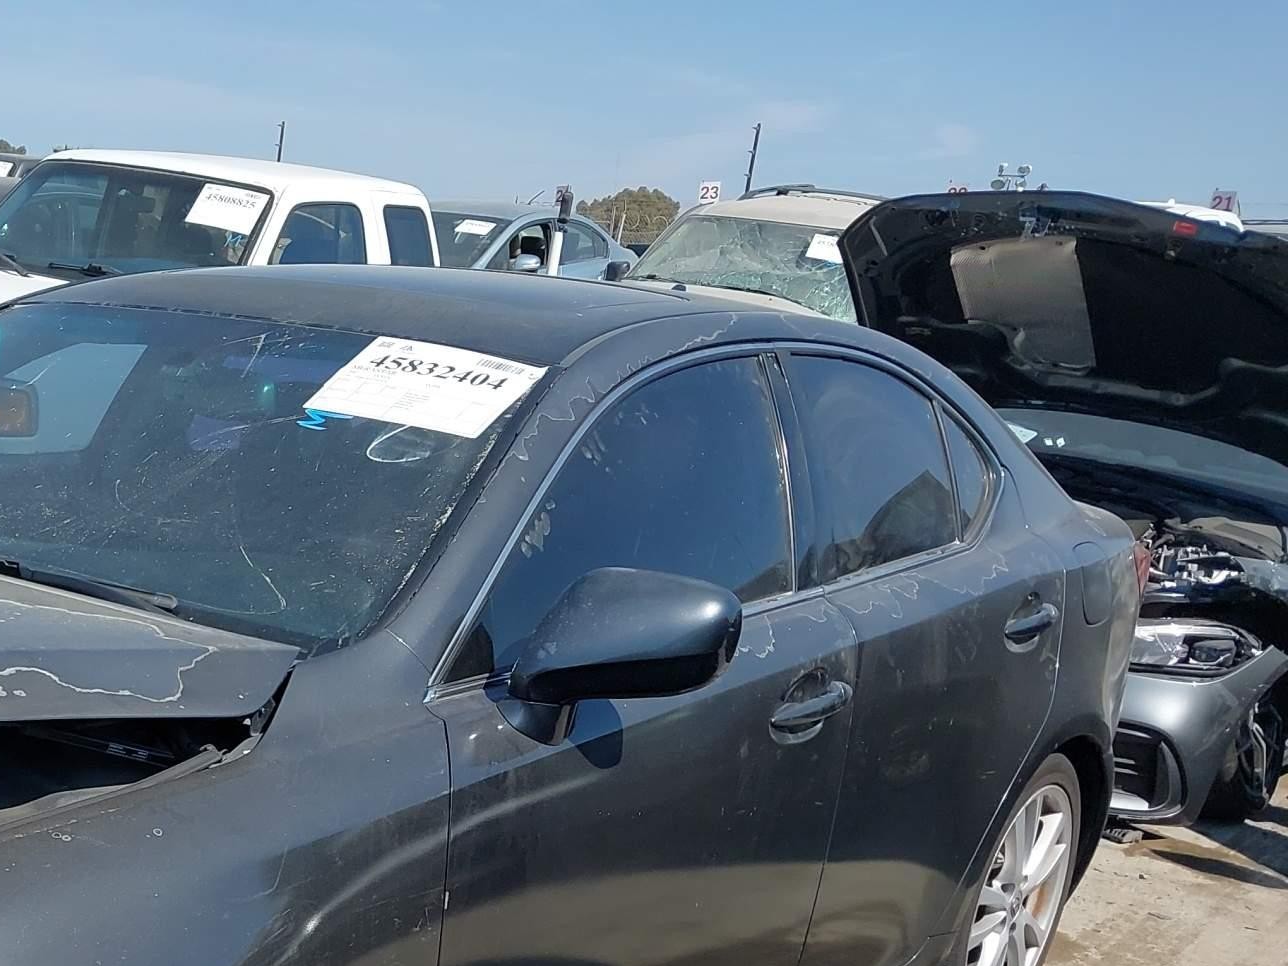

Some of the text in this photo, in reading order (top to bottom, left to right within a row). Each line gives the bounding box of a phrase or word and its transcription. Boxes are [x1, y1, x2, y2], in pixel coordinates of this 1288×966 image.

[700, 186, 719, 200] 23
[1210, 195, 1233, 211] 21
[370, 354, 509, 390] 45832404
